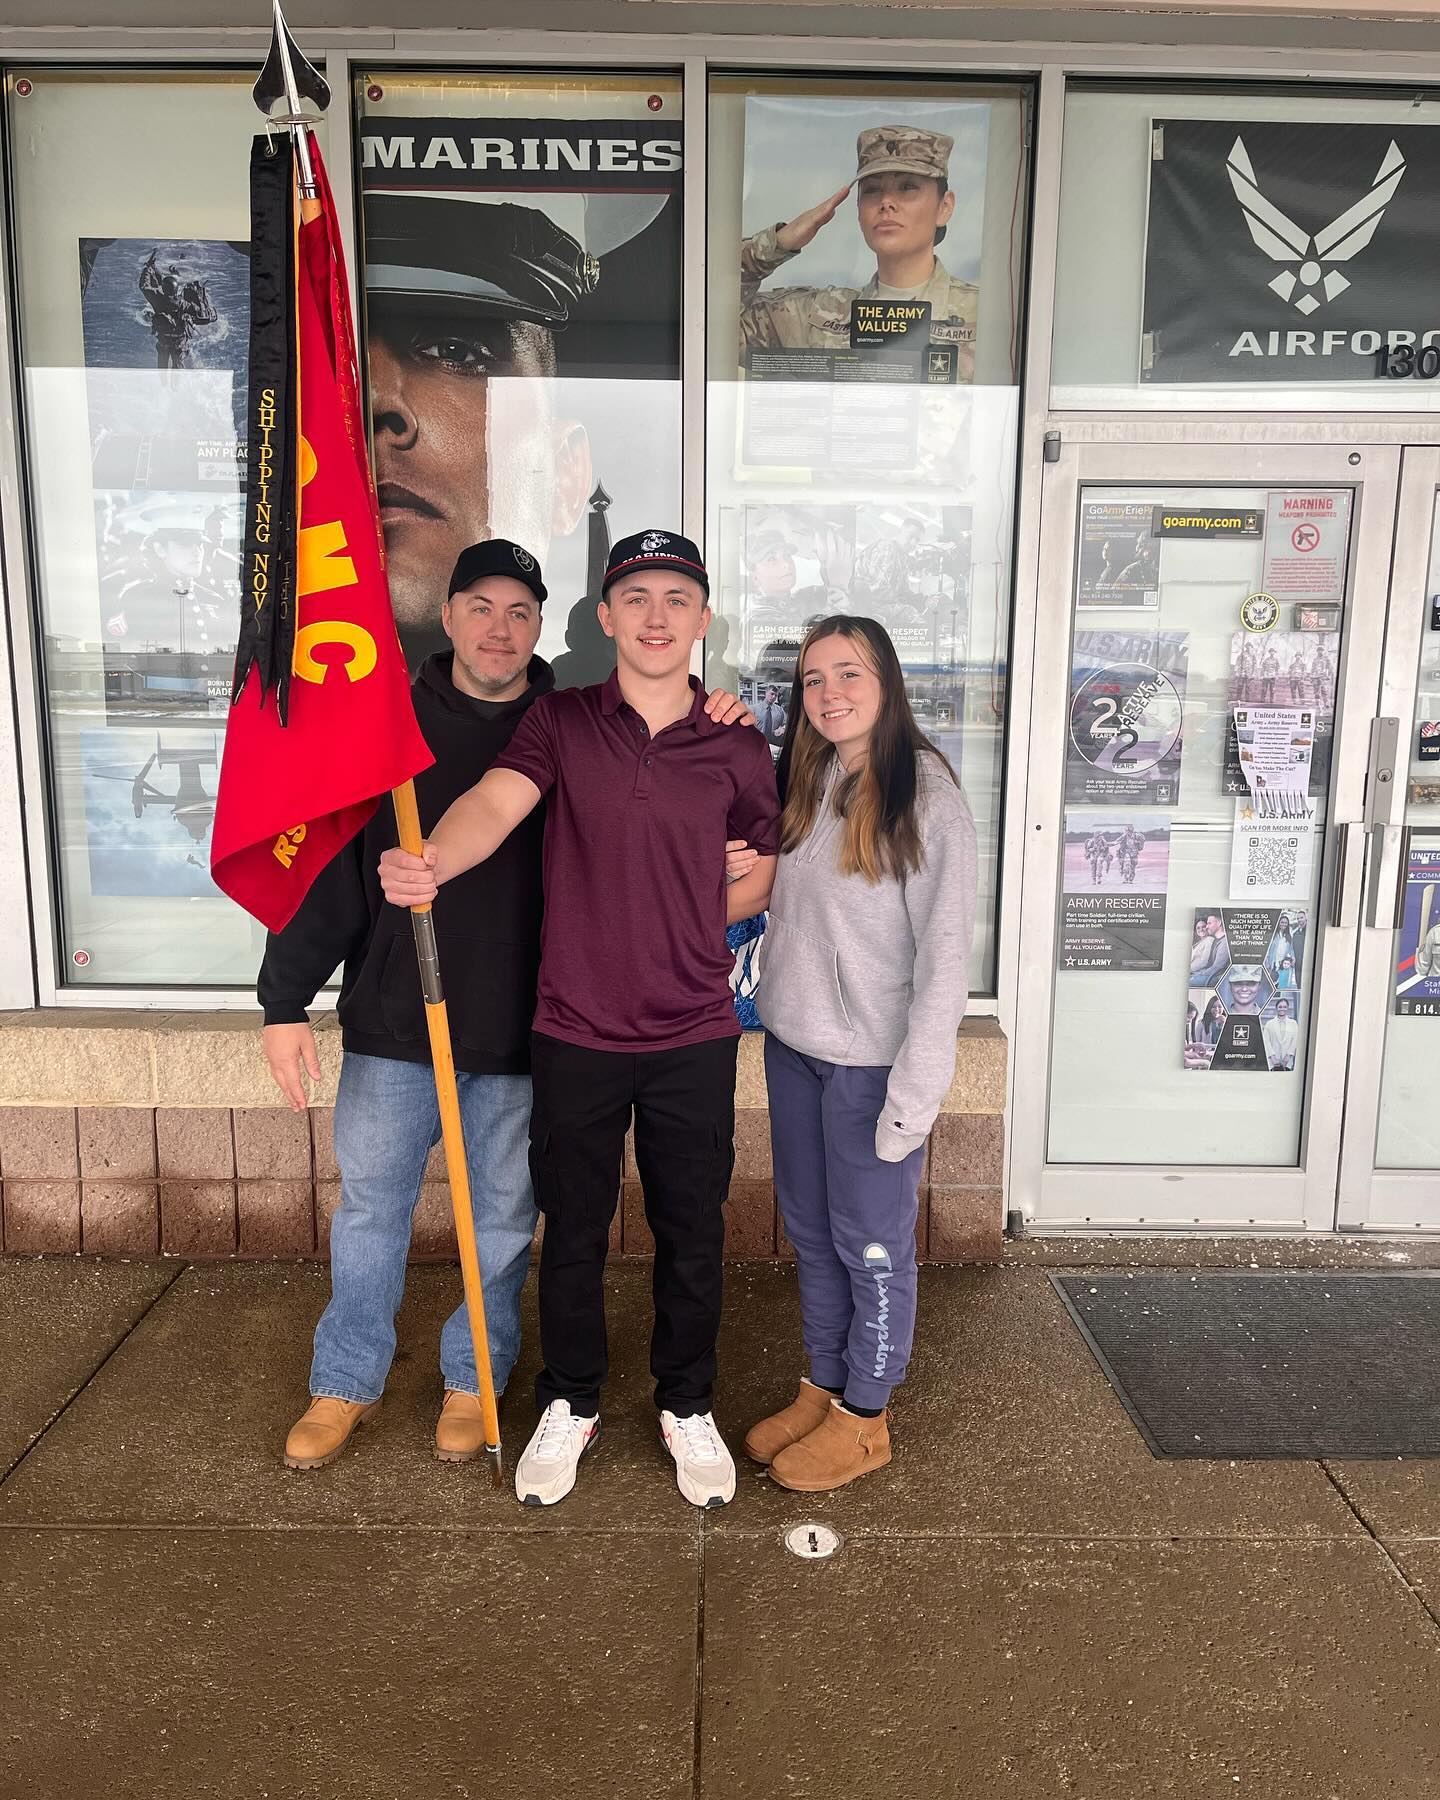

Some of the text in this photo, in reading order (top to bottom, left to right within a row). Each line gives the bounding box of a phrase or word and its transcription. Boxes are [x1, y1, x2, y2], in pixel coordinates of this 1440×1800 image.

[361, 136, 682, 171] MARINES
[858, 306, 925, 319] THE ARMY
[857, 321, 908, 333] VALUES
[945, 330, 973, 339] ARMY
[198, 448, 219, 457] ANY
[252, 388, 277, 610] SHIPPING NOV
[1284, 498, 1334, 510] WARNING
[1163, 516, 1241, 530] goarmy.com
[893, 628, 928, 636] RESPECT
[1117, 681, 1150, 724] ACTIVE
[1123, 676, 1165, 729] RESERVE
[1089, 697, 1120, 733] 2
[1111, 728, 1138, 763] 2
[1281, 810, 1314, 820] ARMY
[1067, 898, 1162, 910] ARMY RESERVE.
[863, 1242, 894, 1378] Champion
